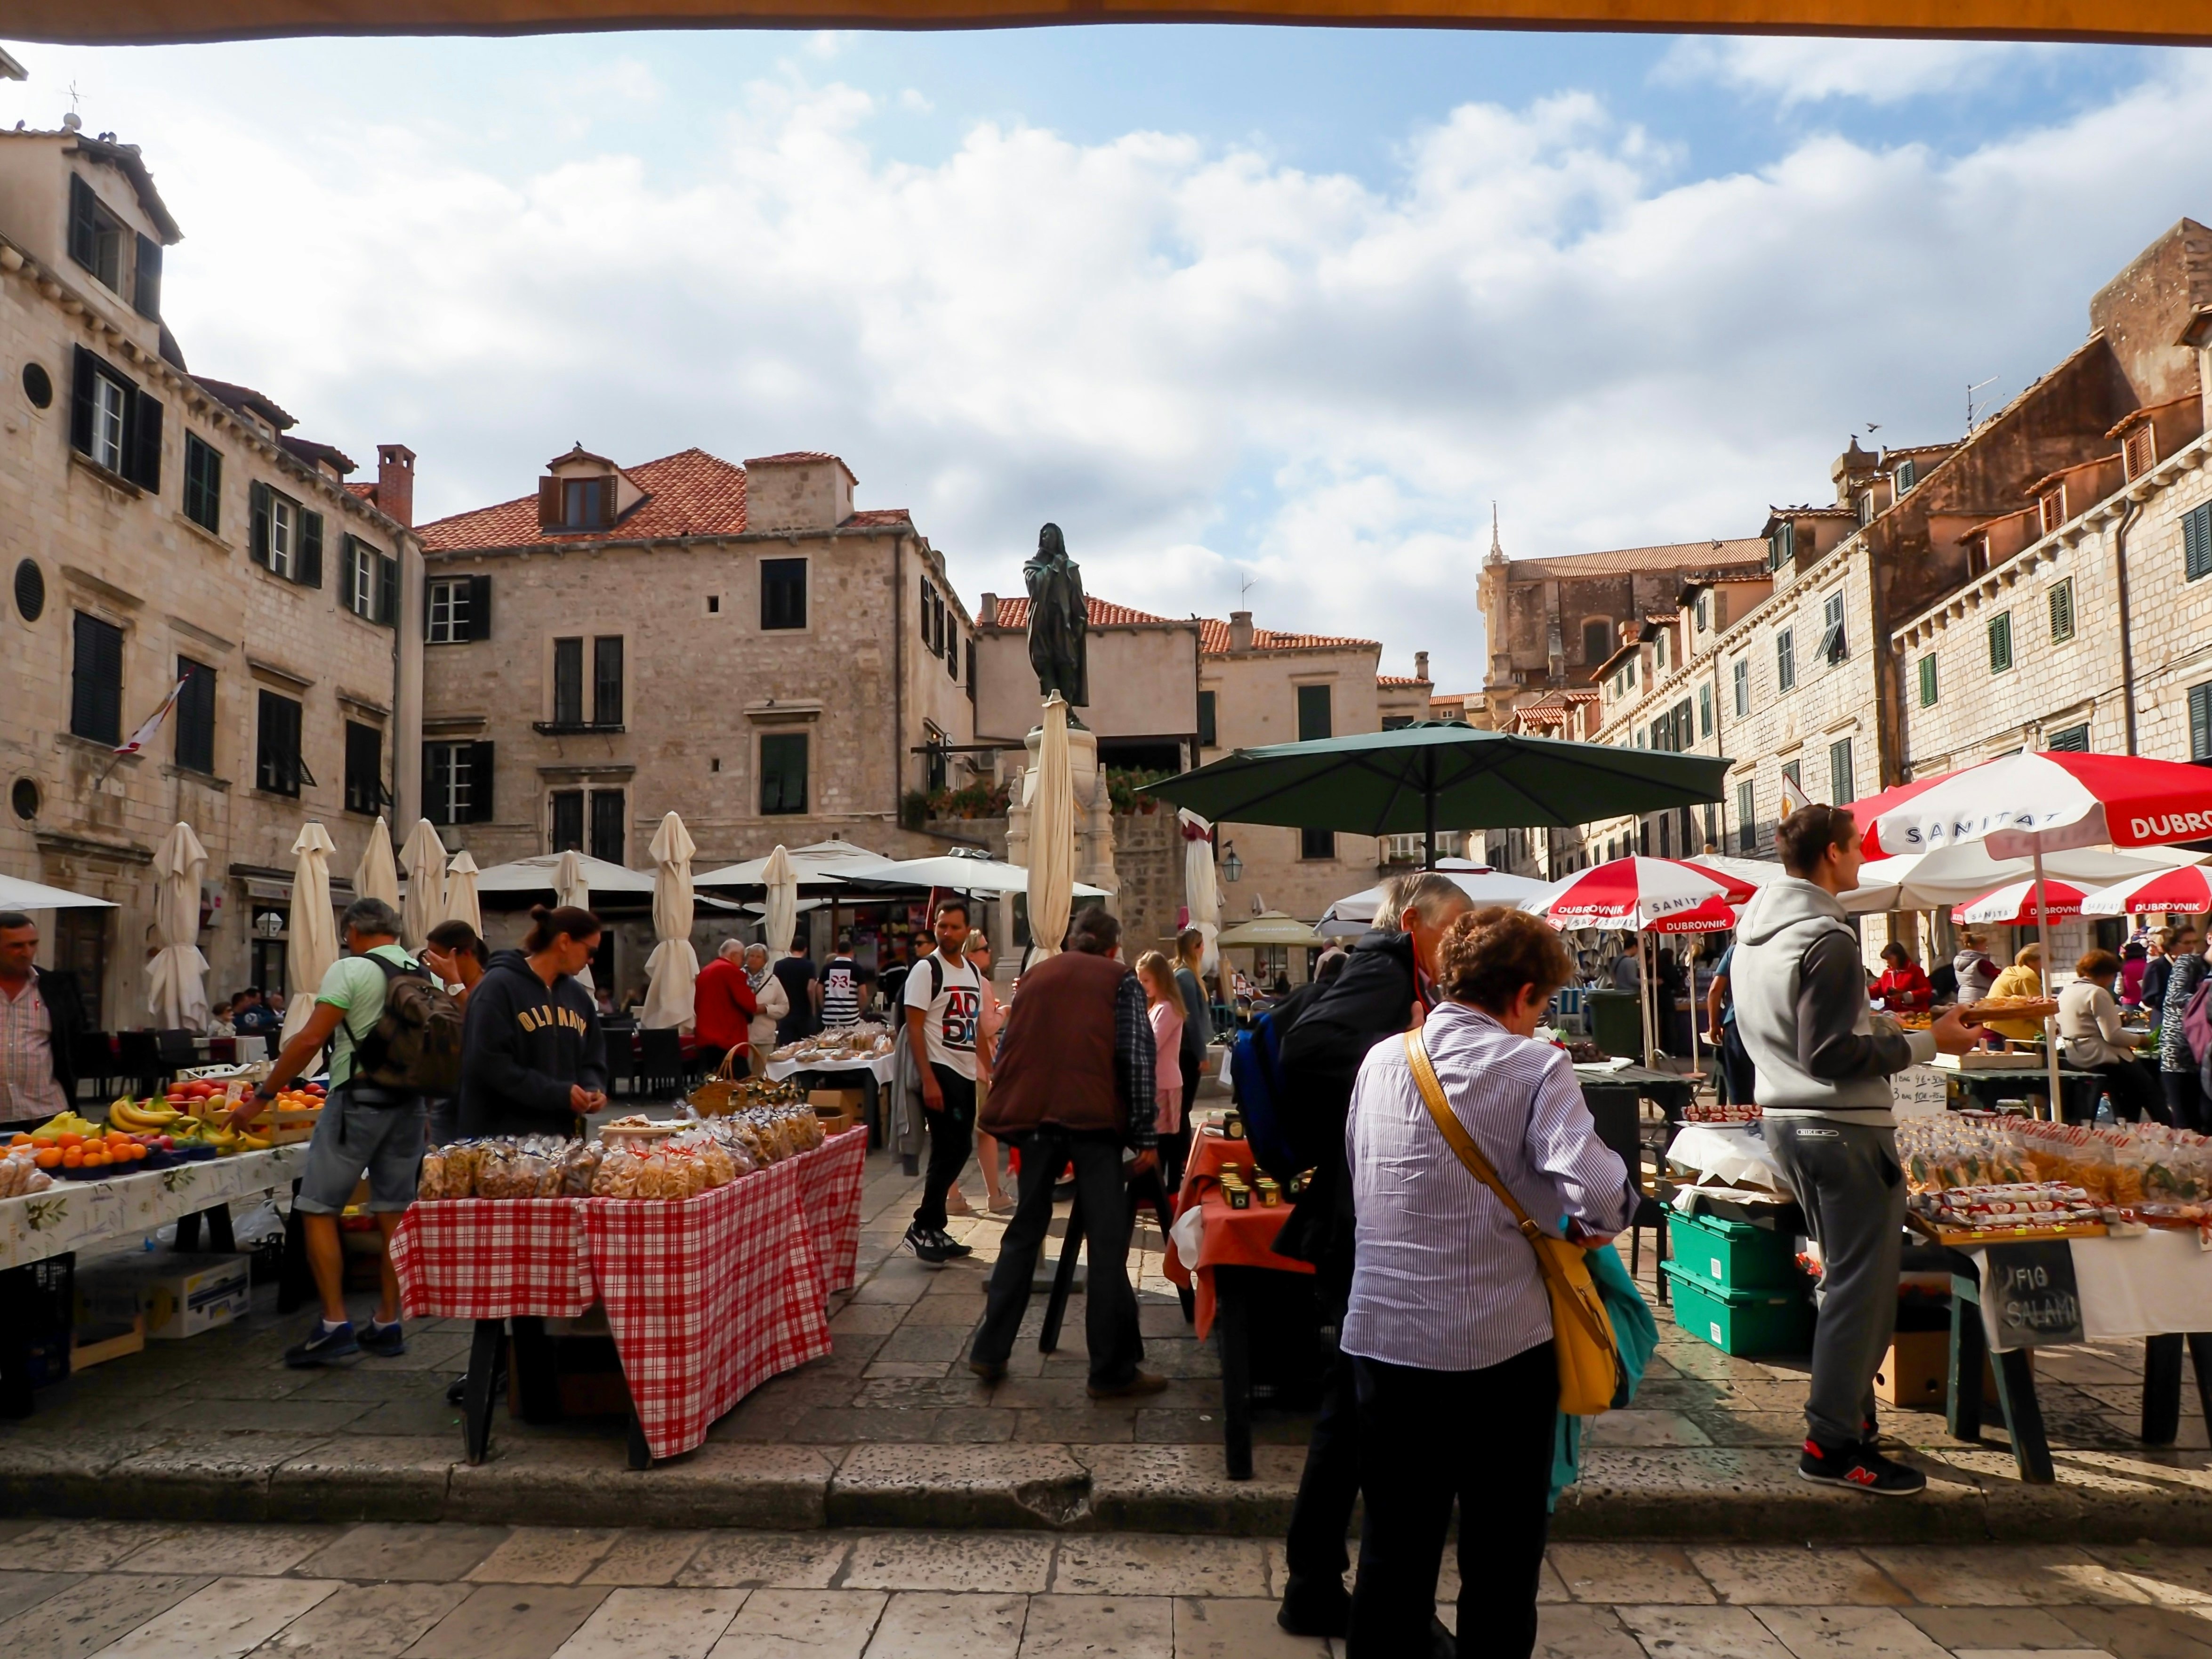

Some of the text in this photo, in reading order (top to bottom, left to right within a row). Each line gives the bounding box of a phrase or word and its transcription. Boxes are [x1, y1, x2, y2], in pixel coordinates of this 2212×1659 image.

[1905, 812, 2062, 844] SANITAT
[1558, 904, 1625, 915] DUBROVNIK
[1652, 897, 1703, 912] SANIT
[2030, 905, 2081, 915] DBROVNI
[2135, 902, 2200, 912] DUBROVNIK
[1666, 919, 1726, 931] DUBROVNIK
[831, 975, 848, 988] 93
[1894, 1087, 1899, 1100] 3
[2016, 1266, 2048, 1290] FIG
[1844, 1465, 1877, 1485] N
